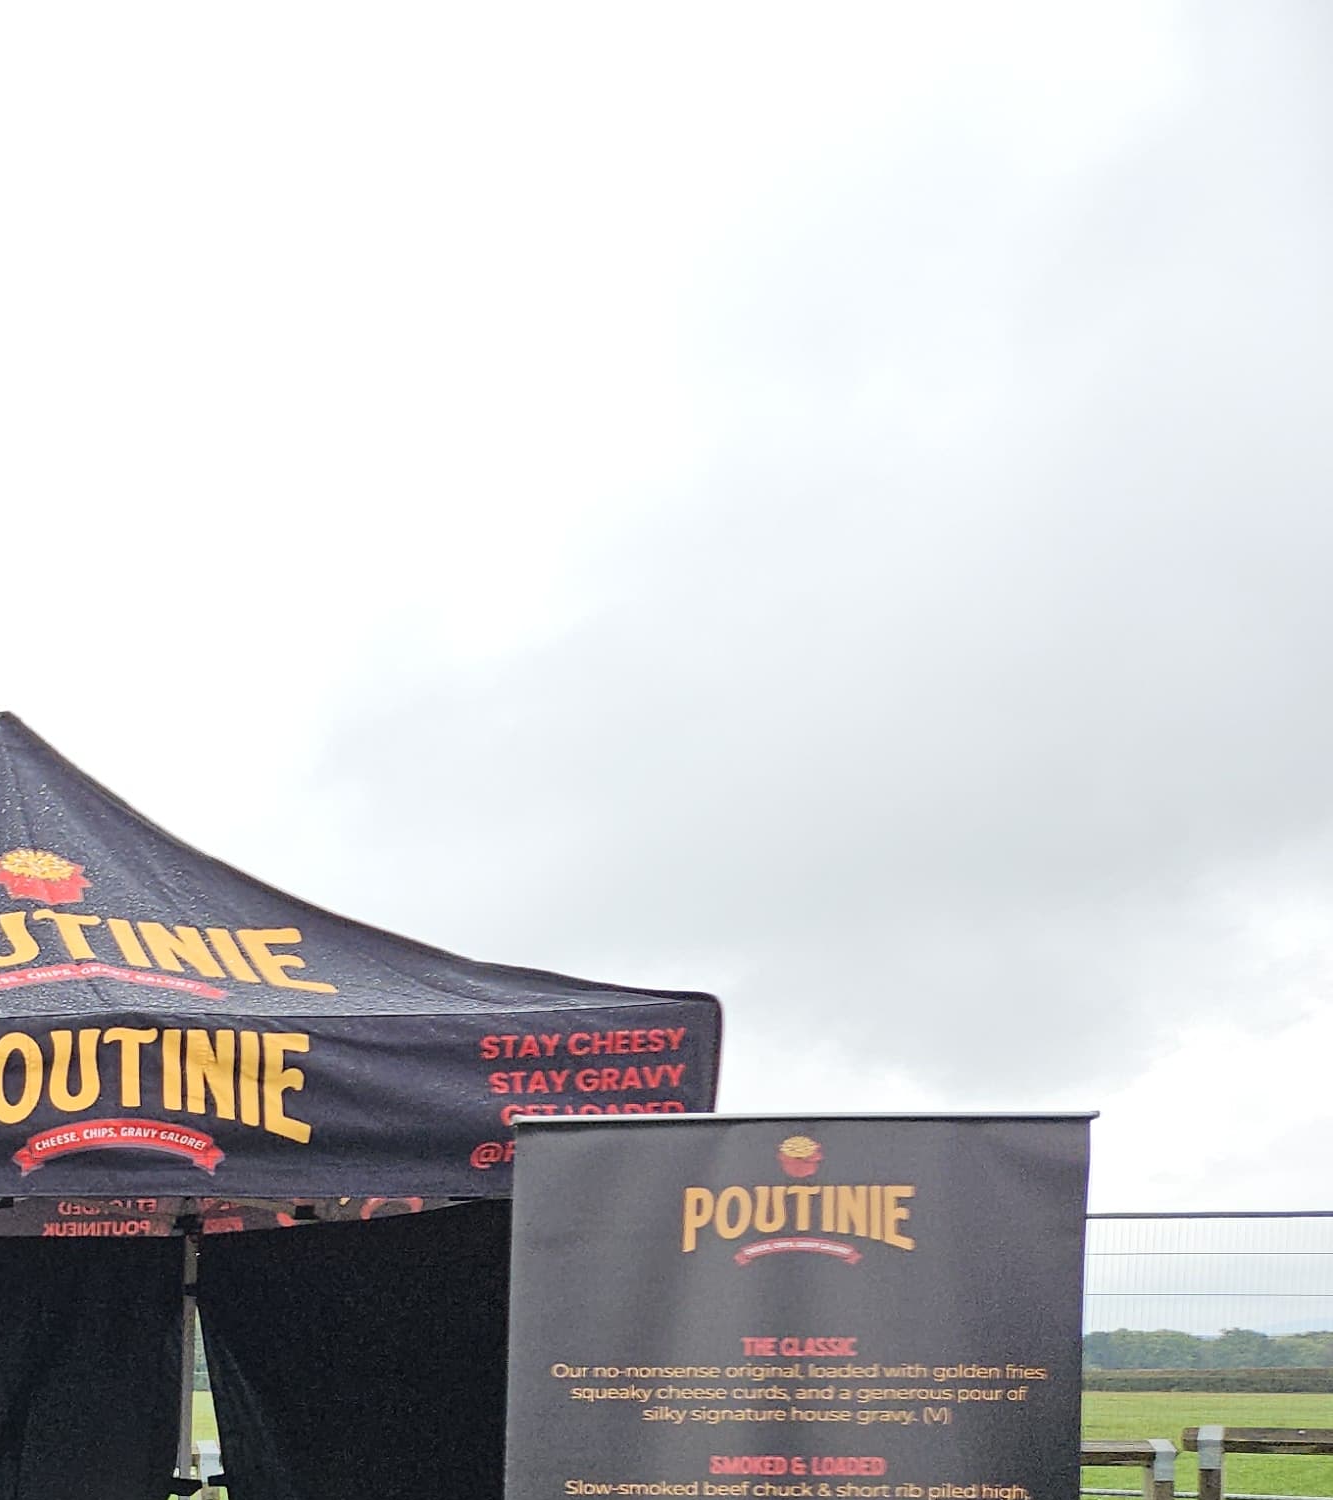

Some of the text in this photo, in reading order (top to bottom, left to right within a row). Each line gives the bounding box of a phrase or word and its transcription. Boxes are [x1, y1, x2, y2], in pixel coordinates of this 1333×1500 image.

[480, 1027, 687, 1060] STAY CHEESY
[489, 1063, 685, 1094] STAY GRAVY
[35, 1131, 80, 1150] CHEESE,
[121, 1128, 158, 1139] GRAVY
[160, 1131, 207, 1150] GALORE!
[682, 1185, 916, 1253] POUTINIE
[741, 1336, 858, 1357] THE CLASSIC
